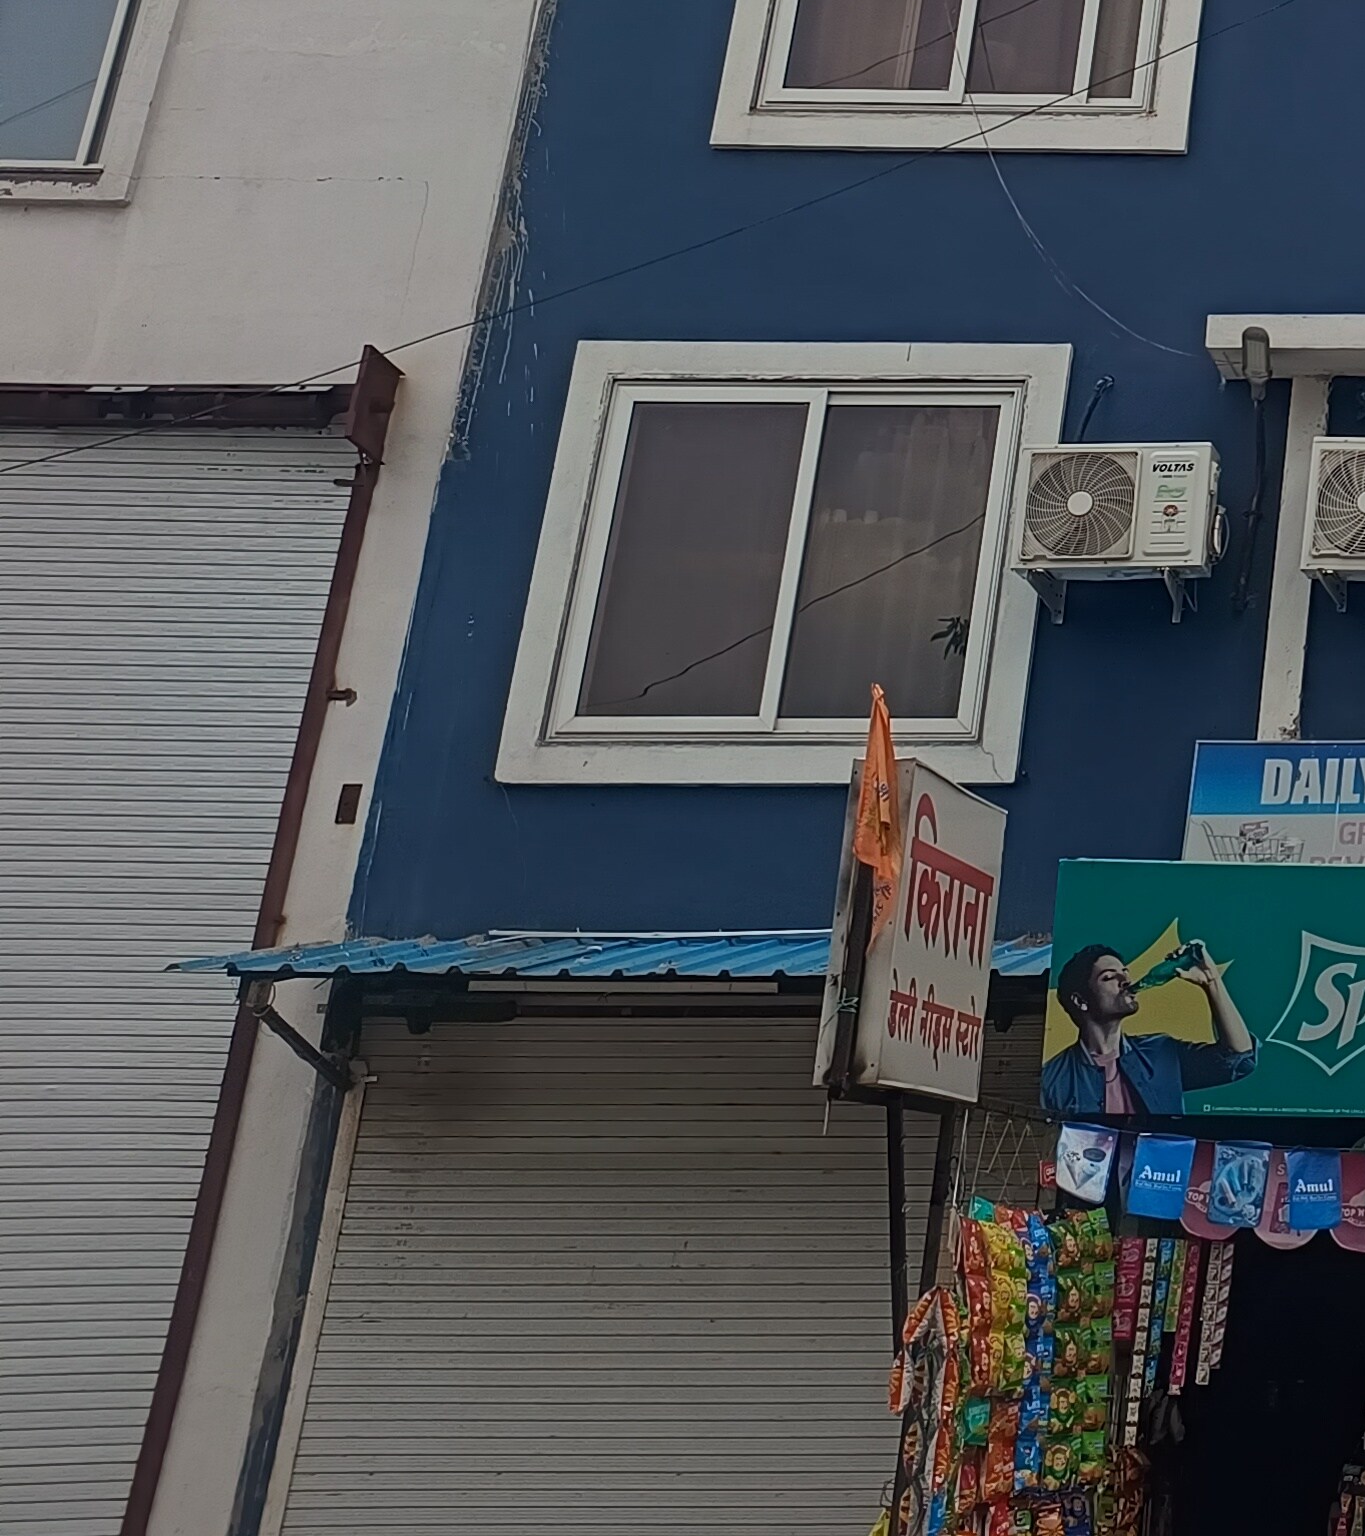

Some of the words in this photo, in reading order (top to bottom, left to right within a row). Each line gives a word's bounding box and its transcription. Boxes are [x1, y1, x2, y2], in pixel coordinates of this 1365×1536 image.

[1152, 463, 1195, 472] VOLTAS
[904, 793, 996, 971] किराना
[1138, 1165, 1181, 1183] Amul
[1294, 1178, 1334, 1193] Amul
